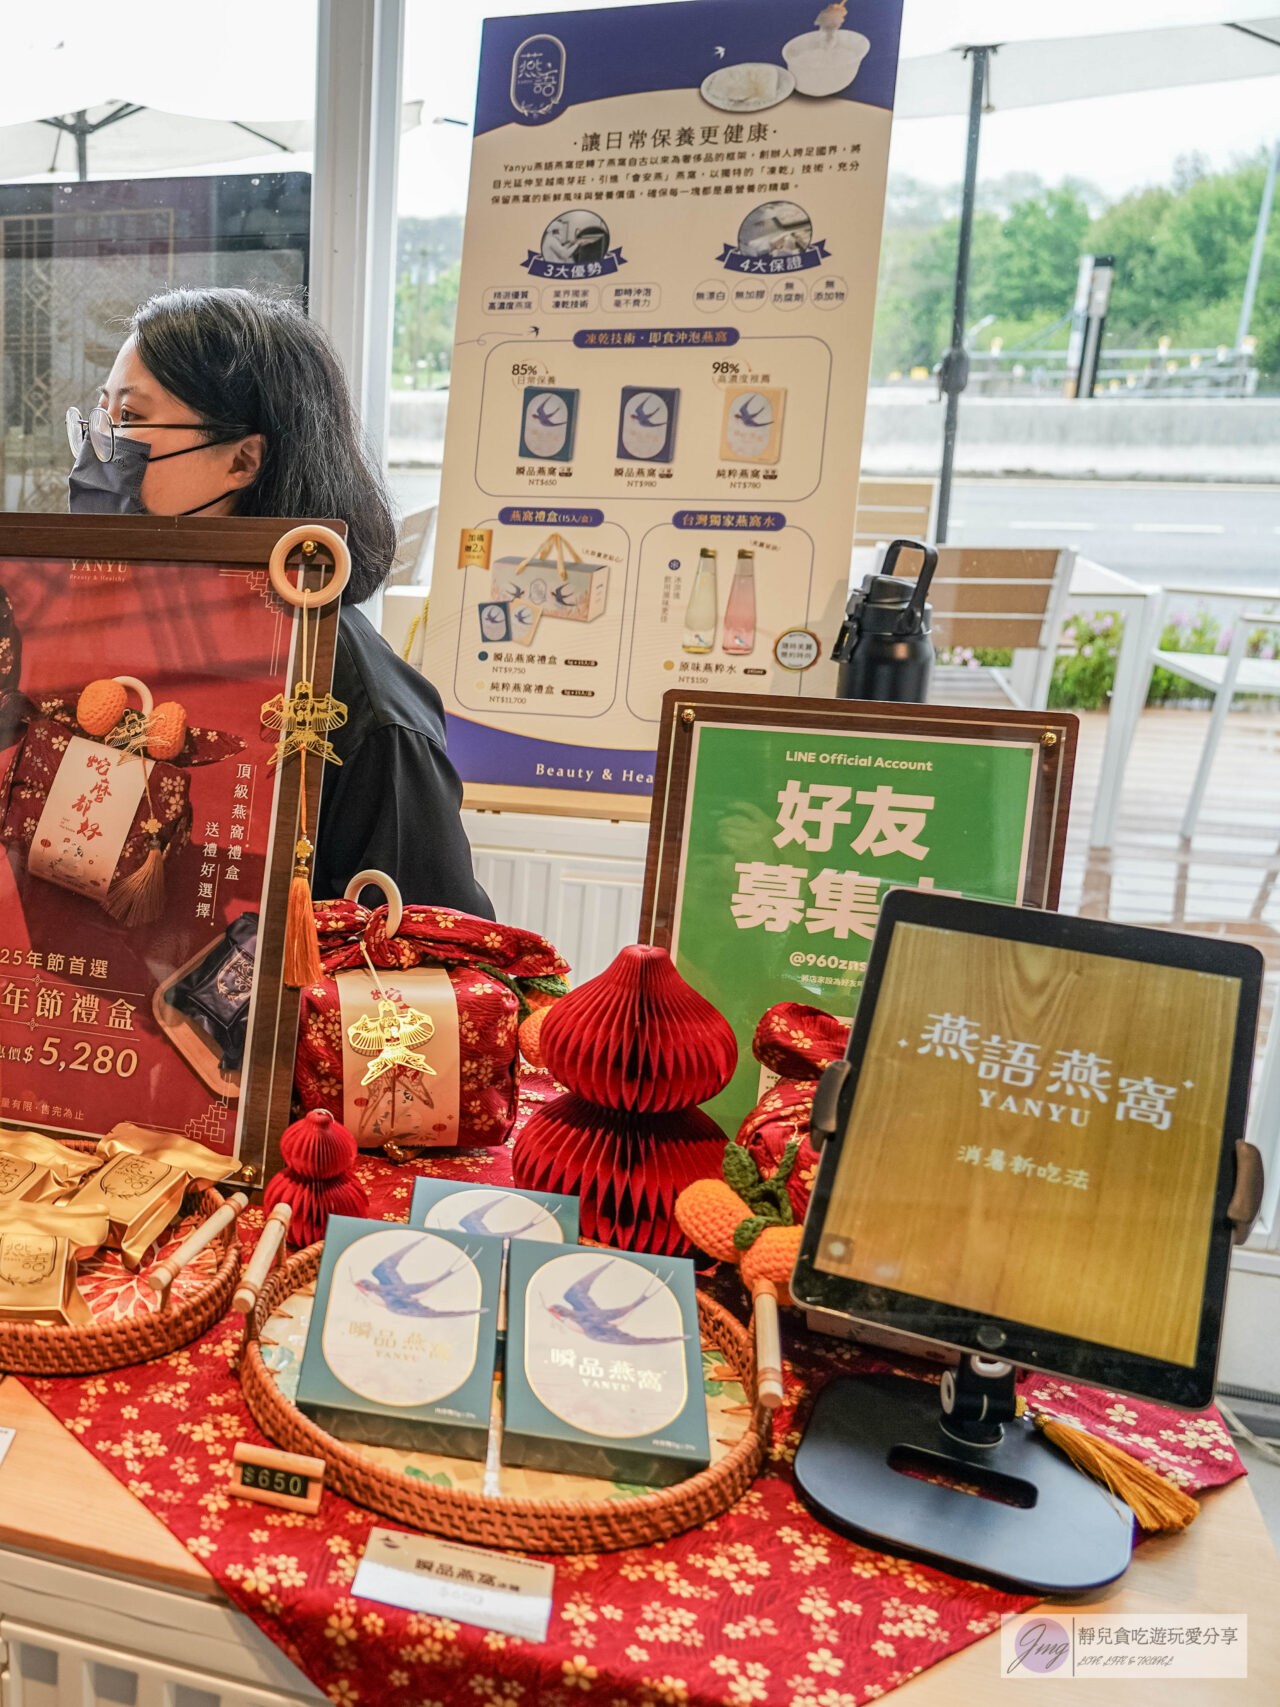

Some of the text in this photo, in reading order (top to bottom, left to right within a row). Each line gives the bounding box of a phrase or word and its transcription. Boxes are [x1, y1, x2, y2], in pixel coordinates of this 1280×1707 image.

[544, 262, 602, 279] 3大優勢
[740, 256, 803, 273] 4大保證
[511, 364, 538, 375] 85%
[712, 361, 740, 374] 98%
[536, 763, 594, 782] Beauty
[602, 768, 613, 781] &
[786, 750, 933, 772] LINE Official Account
[224, 763, 252, 881] 頂級燕窩禮盒
[772, 779, 935, 861] 好友
[195, 822, 220, 918] 送禮好選擇
[917, 1013, 1180, 1131] 燕語燕窩
[978, 1088, 1091, 1127] YANYU
[550, 1348, 664, 1393] 瞬品燕窩
[582, 1378, 632, 1392] YANYU
[243, 1464, 303, 1496] $650
